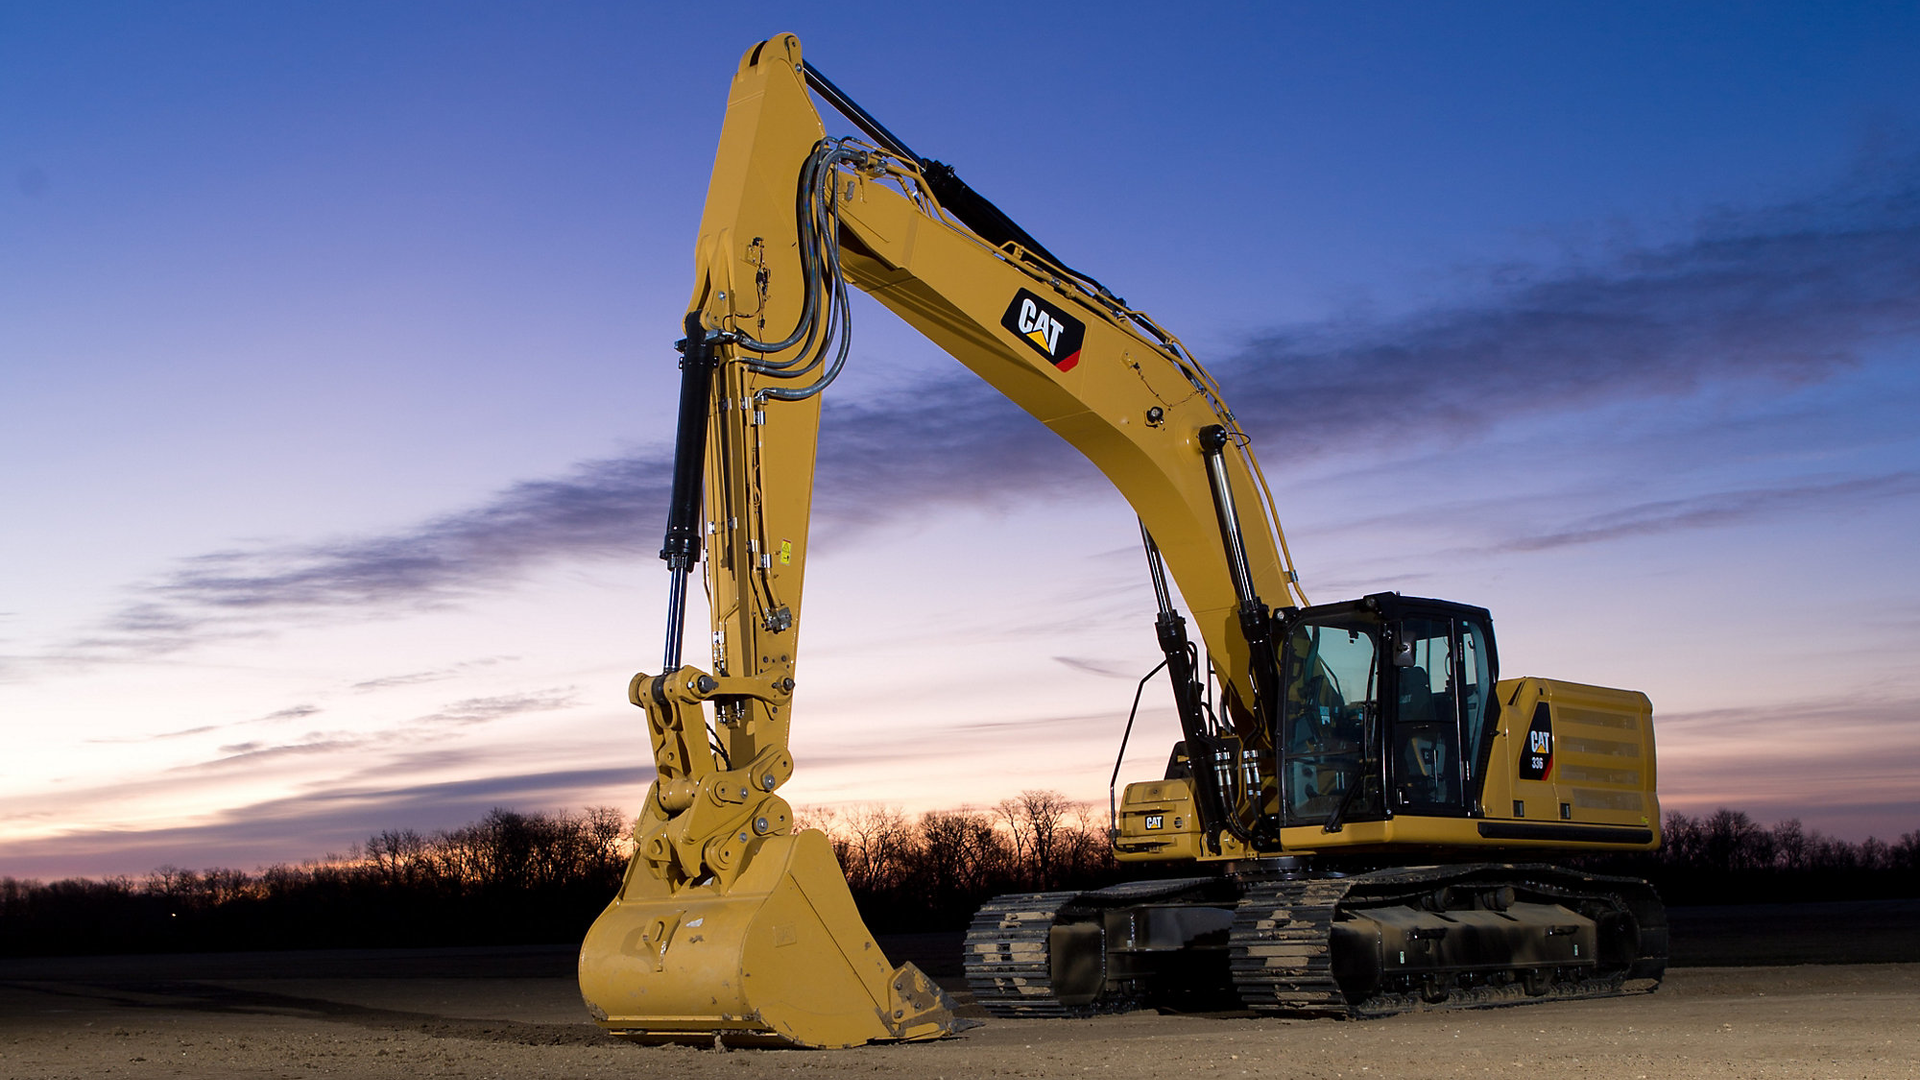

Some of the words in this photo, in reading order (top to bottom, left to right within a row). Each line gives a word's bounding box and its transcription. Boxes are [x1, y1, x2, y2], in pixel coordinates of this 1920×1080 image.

[1018, 298, 1064, 356] CAT
[1530, 730, 1550, 754] CAT
[1531, 756, 1544, 769] 336
[1146, 816, 1162, 829] CAT
